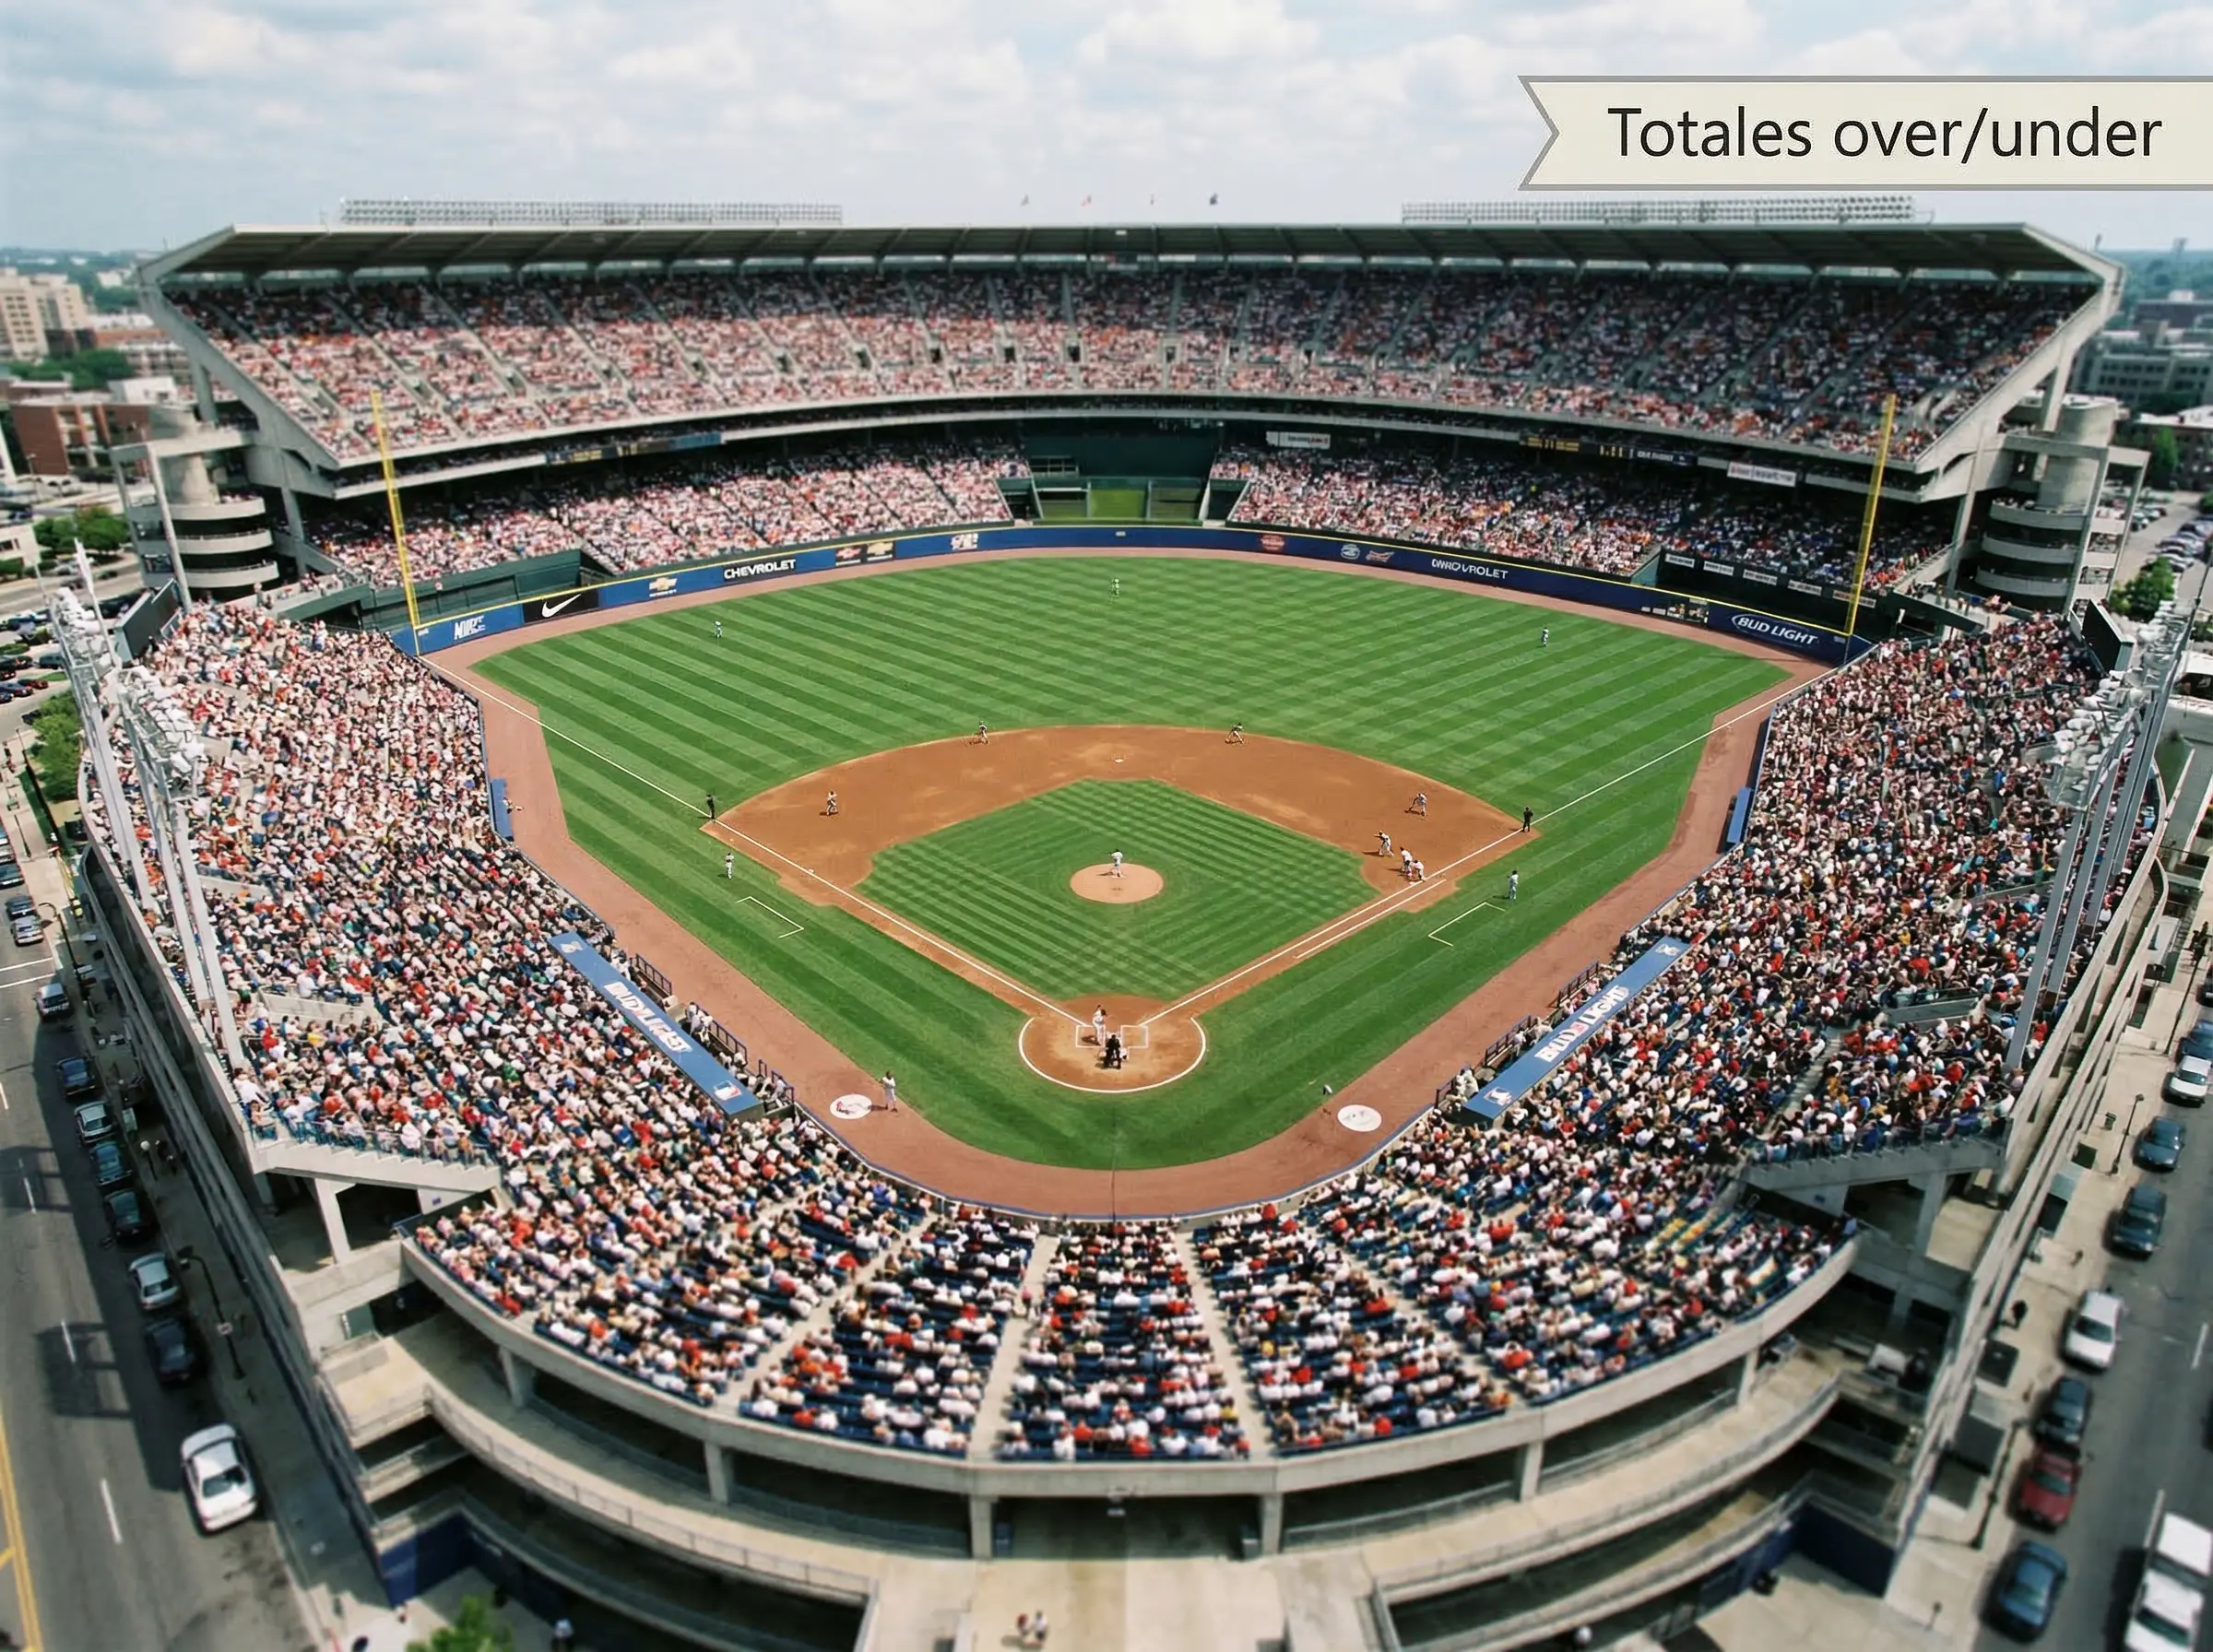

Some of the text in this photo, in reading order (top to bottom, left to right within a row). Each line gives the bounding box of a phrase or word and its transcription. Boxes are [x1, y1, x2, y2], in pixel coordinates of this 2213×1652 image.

[724, 559, 796, 579] CHEVROLET
[1737, 617, 1818, 644] BUD LIGHT
